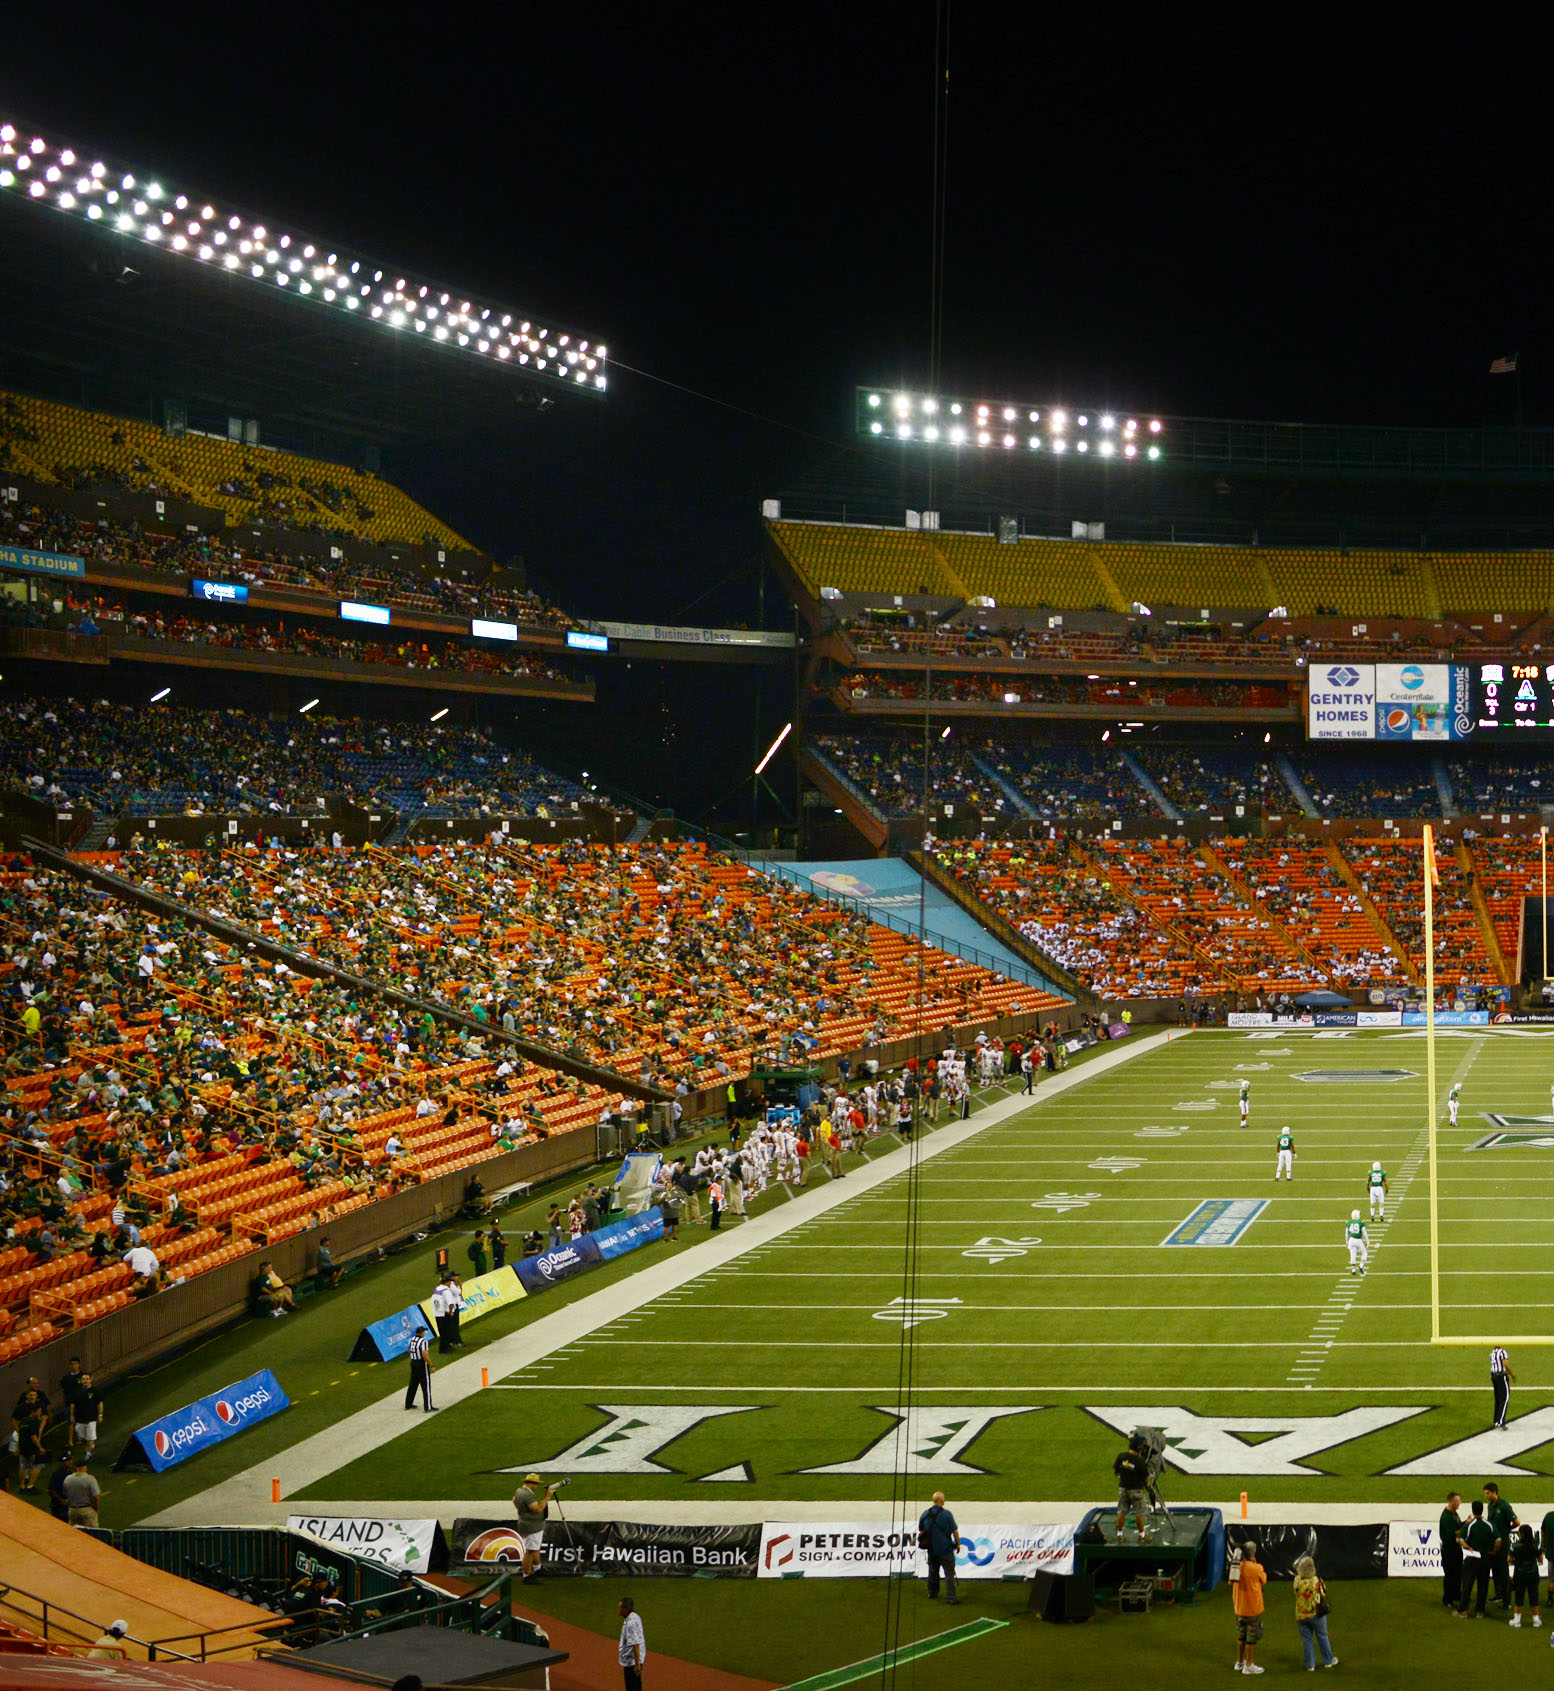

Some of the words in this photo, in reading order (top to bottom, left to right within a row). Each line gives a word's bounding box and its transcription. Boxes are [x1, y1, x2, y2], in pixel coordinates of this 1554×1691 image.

[22, 554, 79, 572] STADIUM
[654, 627, 700, 642] Business
[1390, 692, 1435, 702] Centerplate
[1454, 666, 1465, 714] Oceanic
[1486, 683, 1497, 698] 0
[1310, 693, 1374, 705] GENTRY
[1316, 710, 1369, 722] HOMES
[1318, 730, 1343, 738] SINCE
[1346, 730, 1368, 738] 1968
[1031, 1191, 1103, 1209] 30
[961, 1236, 1043, 1259] 20
[548, 1246, 577, 1265] Oceanic
[872, 1296, 964, 1321] 10
[234, 1386, 270, 1417] pepsi
[171, 1415, 208, 1449] pepsi
[799, 1533, 917, 1549] PETERSON
[1000, 1538, 1045, 1549] PACIFIC
[538, 1543, 584, 1563] First
[593, 1544, 684, 1564] Hawaiian
[692, 1546, 748, 1566] Bank
[798, 1551, 833, 1562] SIGN
[842, 1550, 916, 1562] COMPANY
[1006, 1550, 1035, 1562] GOLF
[1393, 1546, 1441, 1556] VACATIO
